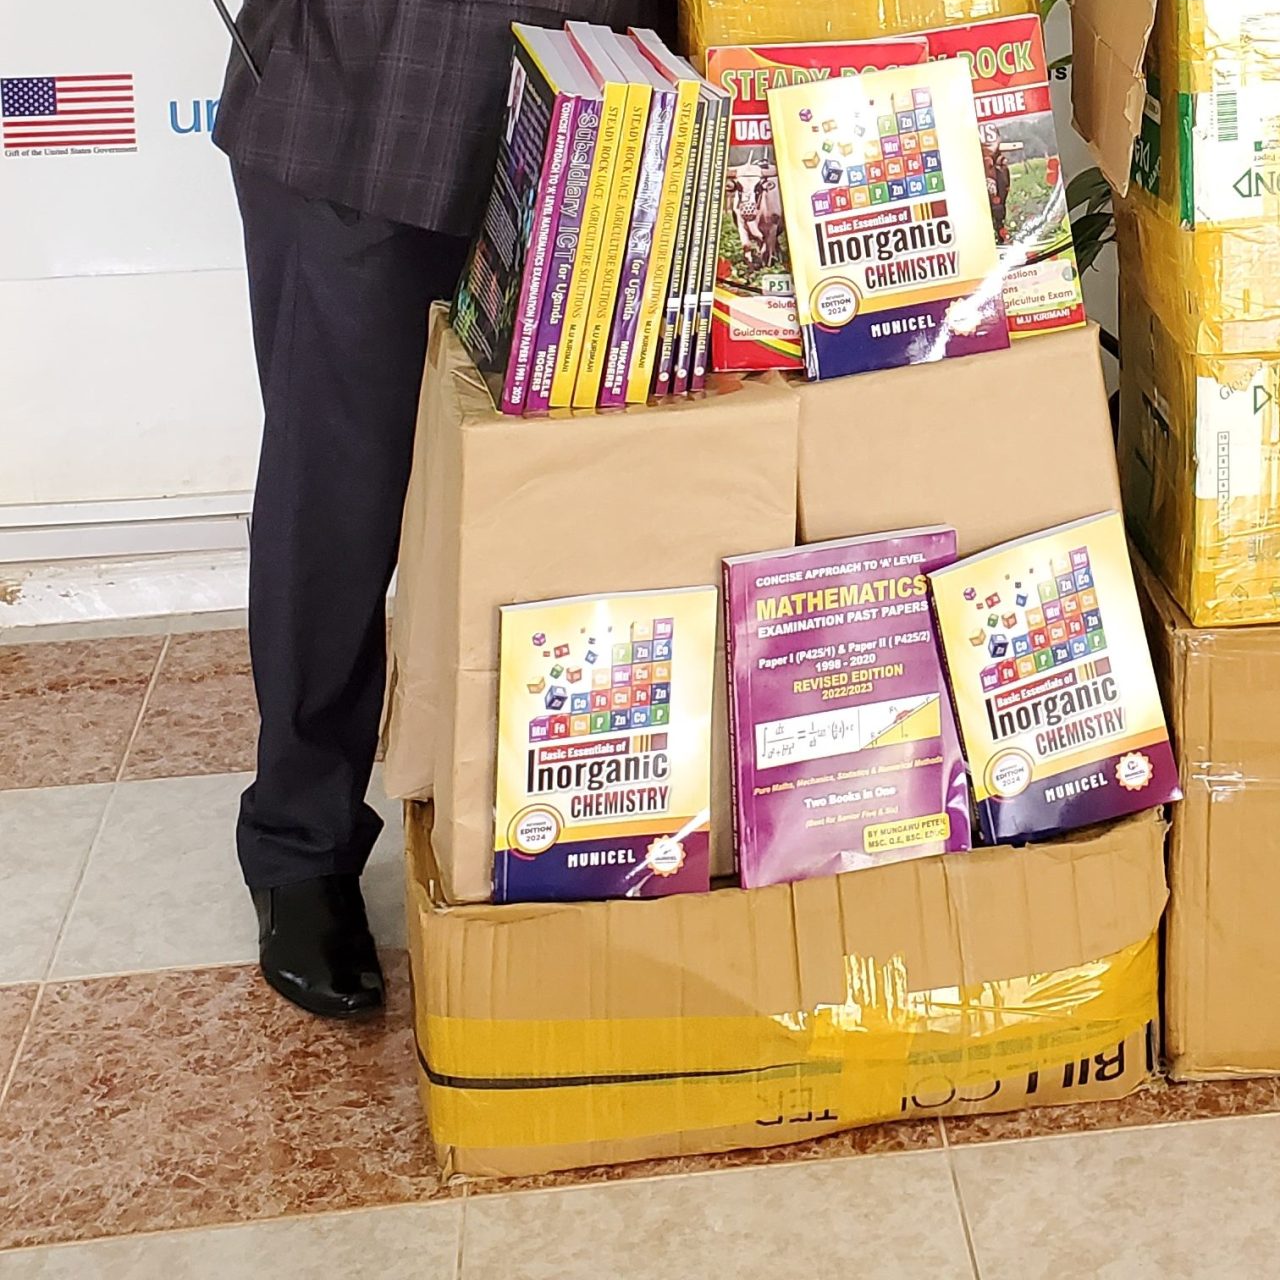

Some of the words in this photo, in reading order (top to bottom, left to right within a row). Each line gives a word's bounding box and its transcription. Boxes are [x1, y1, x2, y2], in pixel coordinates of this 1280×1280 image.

[604, 106, 619, 145] STEADY
[4, 149, 20, 158] Gift
[21, 149, 30, 157] of
[70, 147, 92, 155] States
[93, 146, 138, 154] Government
[560, 113, 599, 218] Subsidiary
[598, 146, 612, 175] ROCK
[593, 175, 607, 200] UACE
[898, 210, 908, 222] of
[554, 226, 580, 262] ICT
[579, 204, 601, 267] AGRICULTURE
[815, 220, 952, 267] Inorganic
[558, 263, 571, 280] for
[864, 251, 957, 290] CHEMISTRY
[550, 283, 567, 325] Uganda
[572, 268, 589, 319] SOLUTIONS
[821, 298, 851, 309] EDITION
[828, 306, 847, 316] 2024
[532, 351, 547, 392] ROGERS
[540, 344, 557, 398] MUKALELE
[756, 570, 803, 588] CONCISE
[804, 562, 862, 580] APPROACH
[863, 560, 878, 571] TO
[893, 553, 927, 567] LEVEL
[756, 574, 929, 621] MATHEMATICS
[758, 612, 845, 639] EXAMINATION
[847, 607, 879, 623] PAST
[881, 600, 929, 618] PAPERS
[758, 654, 788, 669] Paper
[837, 645, 846, 655] &
[848, 639, 877, 655] Paper
[815, 658, 840, 672] 1998
[850, 653, 876, 665] 2020
[793, 672, 849, 694] REVISED
[851, 663, 904, 682] EDITION
[821, 682, 874, 701] 2022/2023
[985, 677, 1118, 741] Inorganic
[1035, 706, 1125, 756] CHEMISTRY
[540, 749, 567, 761] Basic
[568, 742, 615, 758] Essentials
[616, 740, 627, 753] of
[527, 749, 669, 793] Inorganic
[995, 766, 1025, 782] EDITION
[570, 785, 669, 819] CHEMISTRY
[804, 797, 827, 809] Two
[828, 791, 862, 805] Books
[875, 785, 897, 796] One
[520, 825, 552, 836] EDITION
[526, 834, 546, 842] 2024
[867, 830, 879, 838] BY
